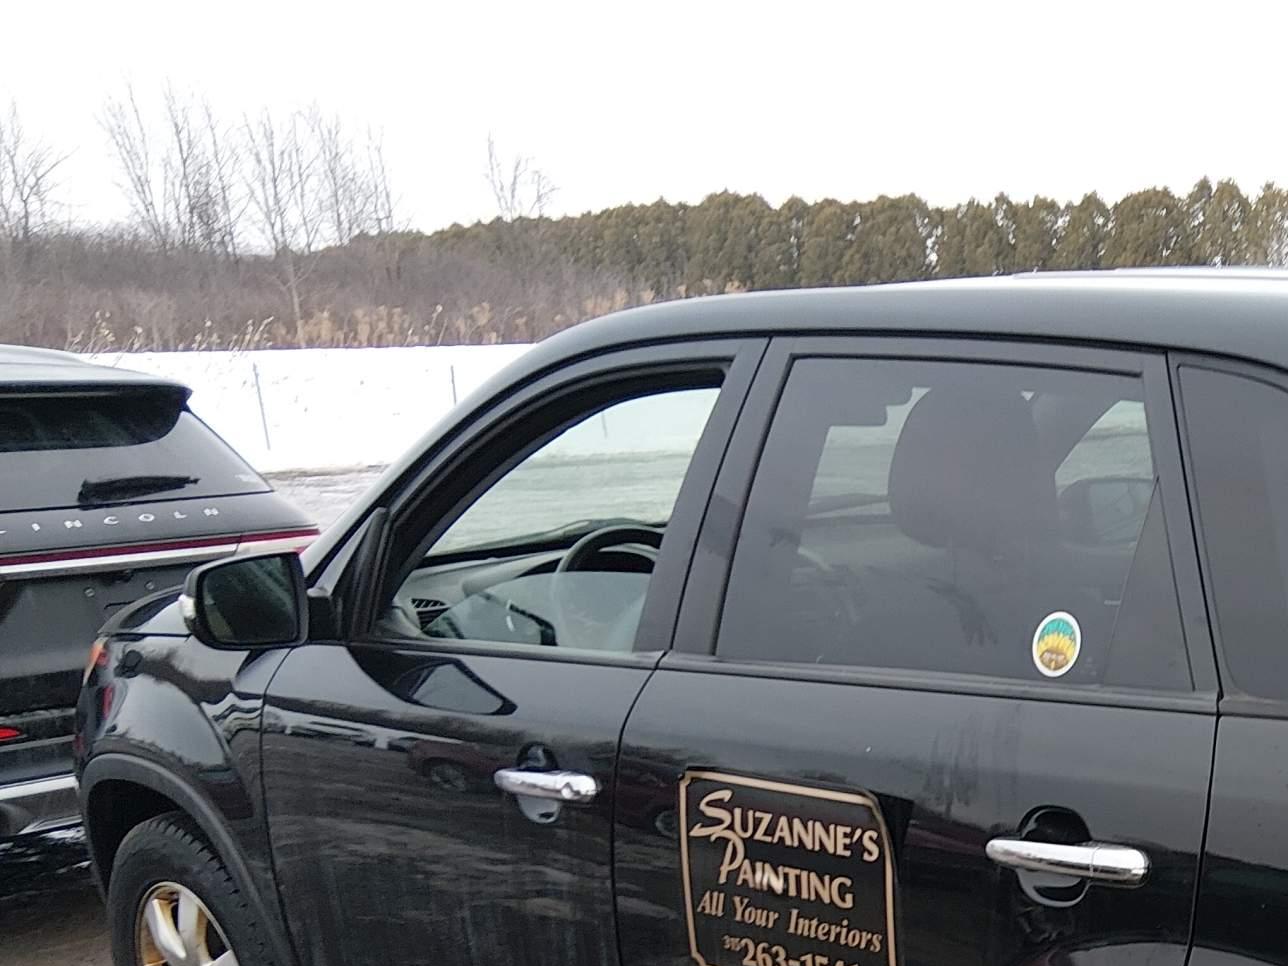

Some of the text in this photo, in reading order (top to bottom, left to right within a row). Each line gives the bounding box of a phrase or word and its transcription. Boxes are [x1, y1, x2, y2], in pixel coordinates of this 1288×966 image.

[689, 790, 880, 862] SUZANNE'S
[710, 831, 854, 908] PAINTING
[697, 890, 883, 953] All Your Interiors
